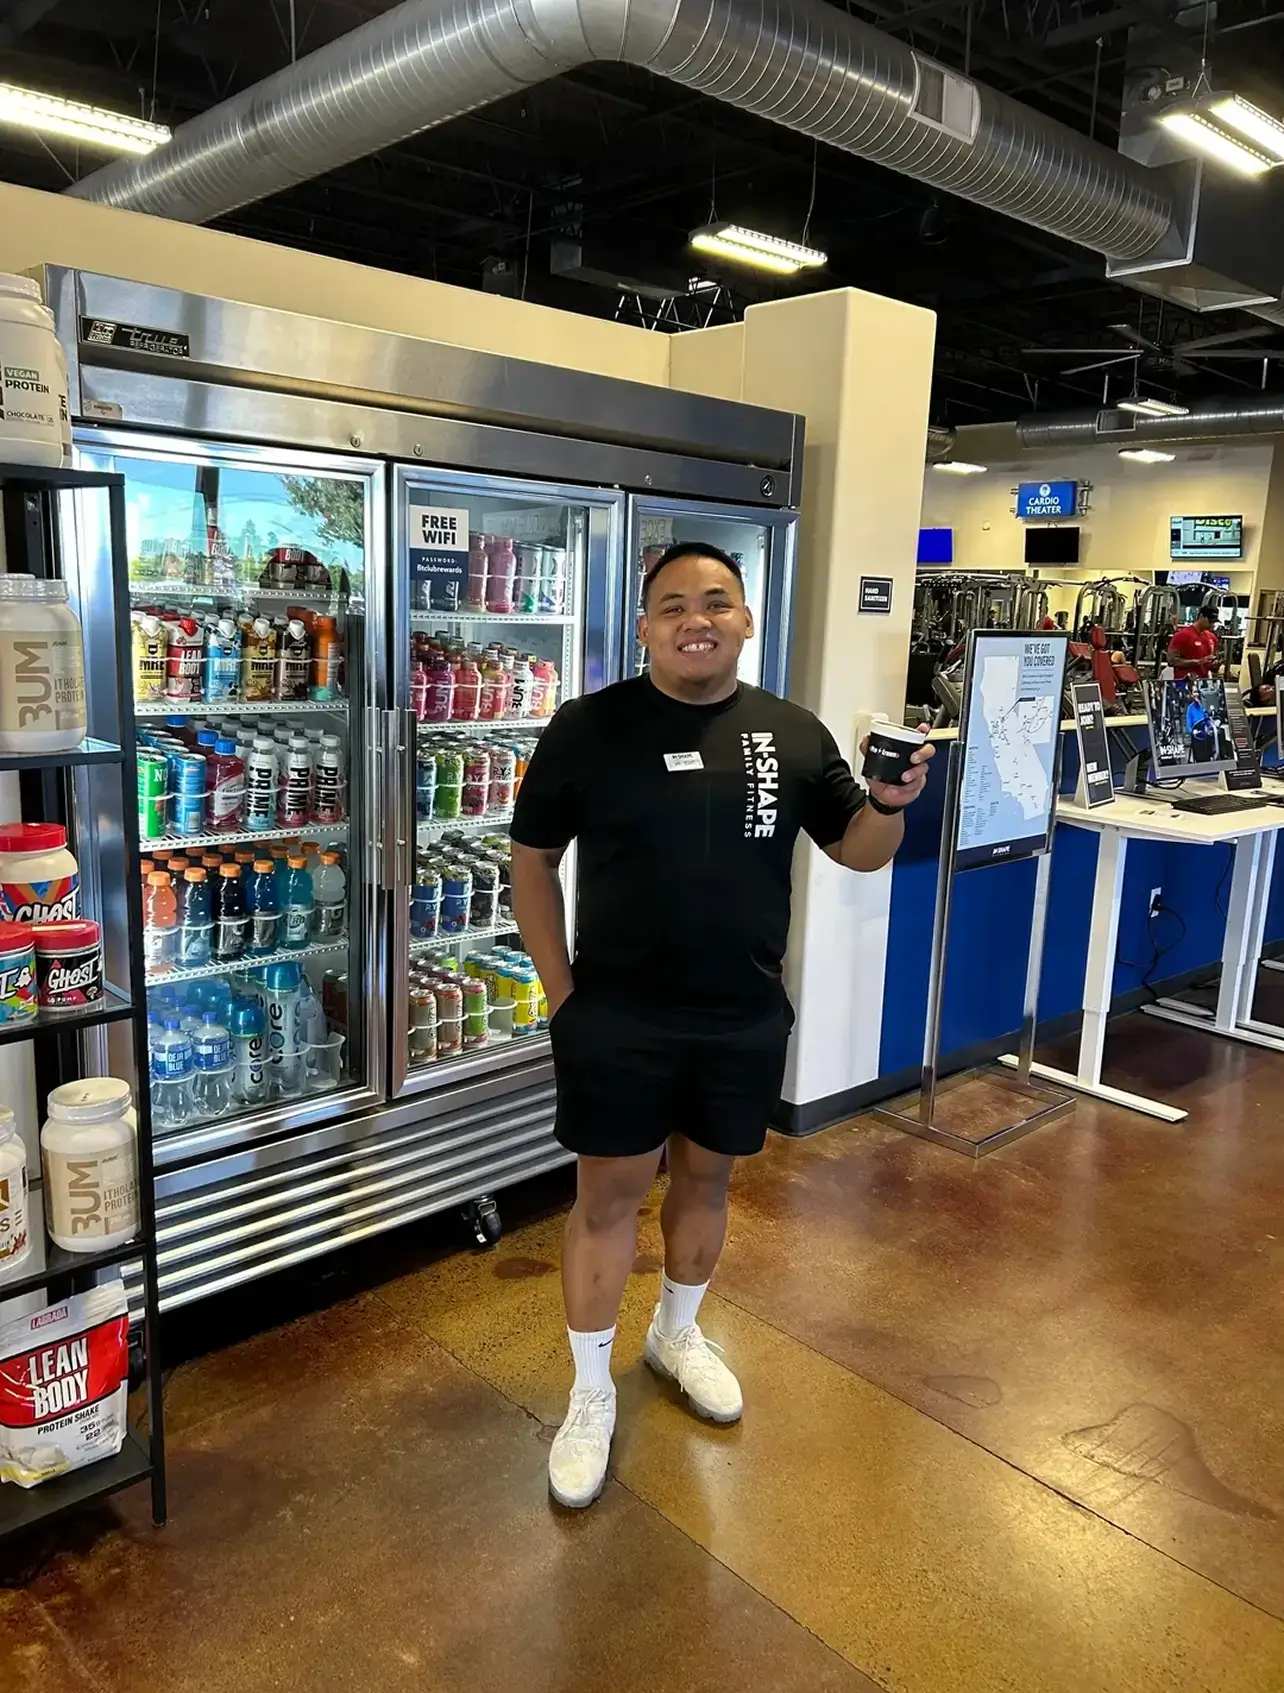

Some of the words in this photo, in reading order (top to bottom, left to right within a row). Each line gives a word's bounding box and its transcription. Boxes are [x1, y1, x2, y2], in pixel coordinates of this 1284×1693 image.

[6, 368, 38, 380] VEGAN
[5, 380, 50, 394] PROTEIN
[6, 410, 45, 421] CHOCOLATE
[1028, 496, 1060, 506] CARDIO
[1025, 505, 1062, 515] THEATER
[421, 514, 457, 530] FREE
[421, 530, 456, 545] WIFI
[416, 564, 462, 574] fitclubrewards
[864, 587, 880, 595] HAND
[1041, 643, 1051, 654] GOT
[1023, 656, 1033, 667] YOU
[1034, 655, 1055, 667] COVERED
[741, 733, 755, 776] FAMILY
[287, 767, 310, 817] PRIME
[751, 732, 779, 838] IN-SHAPE
[744, 782, 755, 838] FITNESS
[48, 955, 99, 990] GHOST
[249, 1038, 263, 1084] core
[31, 1307, 67, 1329] LABRADA
[28, 1337, 89, 1386] LEAN
[33, 1368, 89, 1420] BODY
[37, 1415, 74, 1435] PROTEIN
[74, 1404, 100, 1425] SHAKE
[85, 1428, 101, 1441] 22
